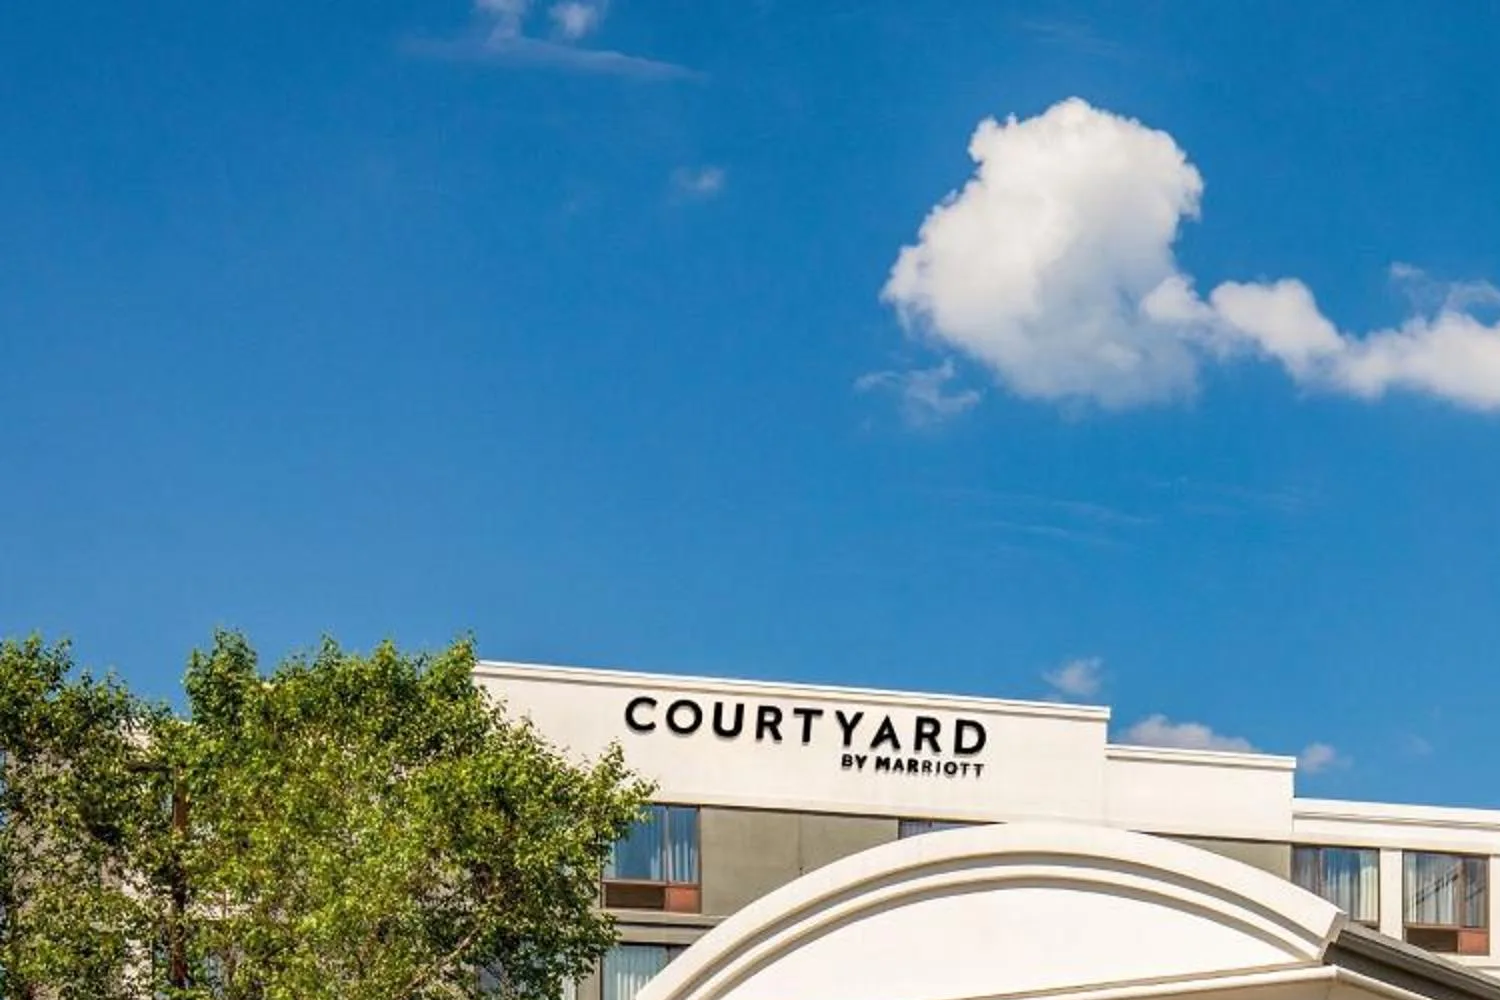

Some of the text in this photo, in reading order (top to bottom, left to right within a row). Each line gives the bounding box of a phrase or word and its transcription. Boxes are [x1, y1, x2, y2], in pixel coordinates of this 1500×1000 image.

[625, 696, 987, 755] COURTYARD
[841, 753, 984, 777] BY MARRIOTT
